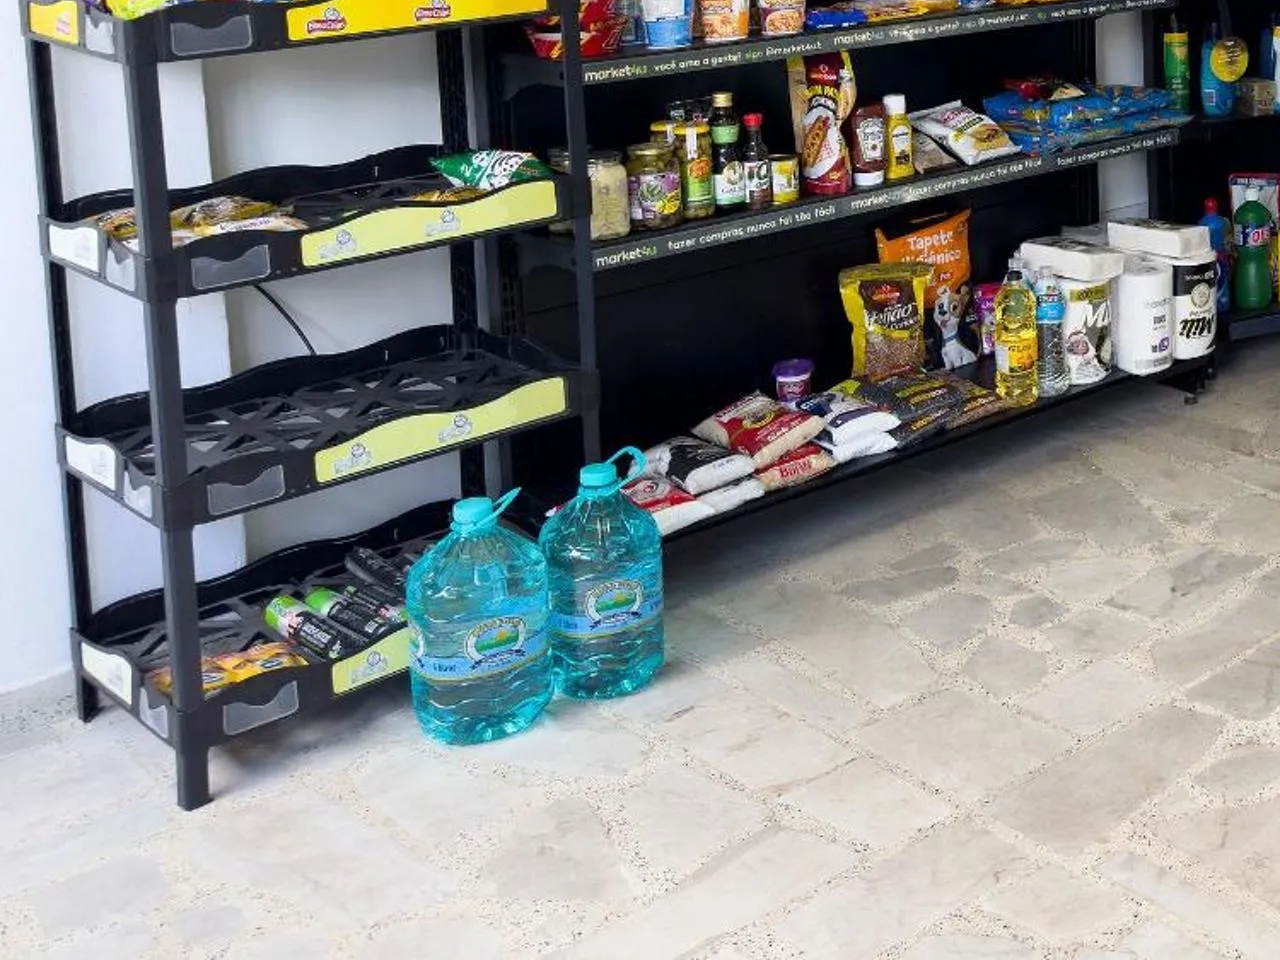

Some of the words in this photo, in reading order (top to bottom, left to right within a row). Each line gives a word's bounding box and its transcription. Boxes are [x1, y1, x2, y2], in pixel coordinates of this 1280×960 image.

[584, 66, 648, 83] market4u
[596, 245, 658, 268] market4u
[668, 236, 696, 250] fazer
[698, 227, 744, 246] compras
[746, 220, 776, 234] nunca
[907, 230, 954, 253] Tapete
